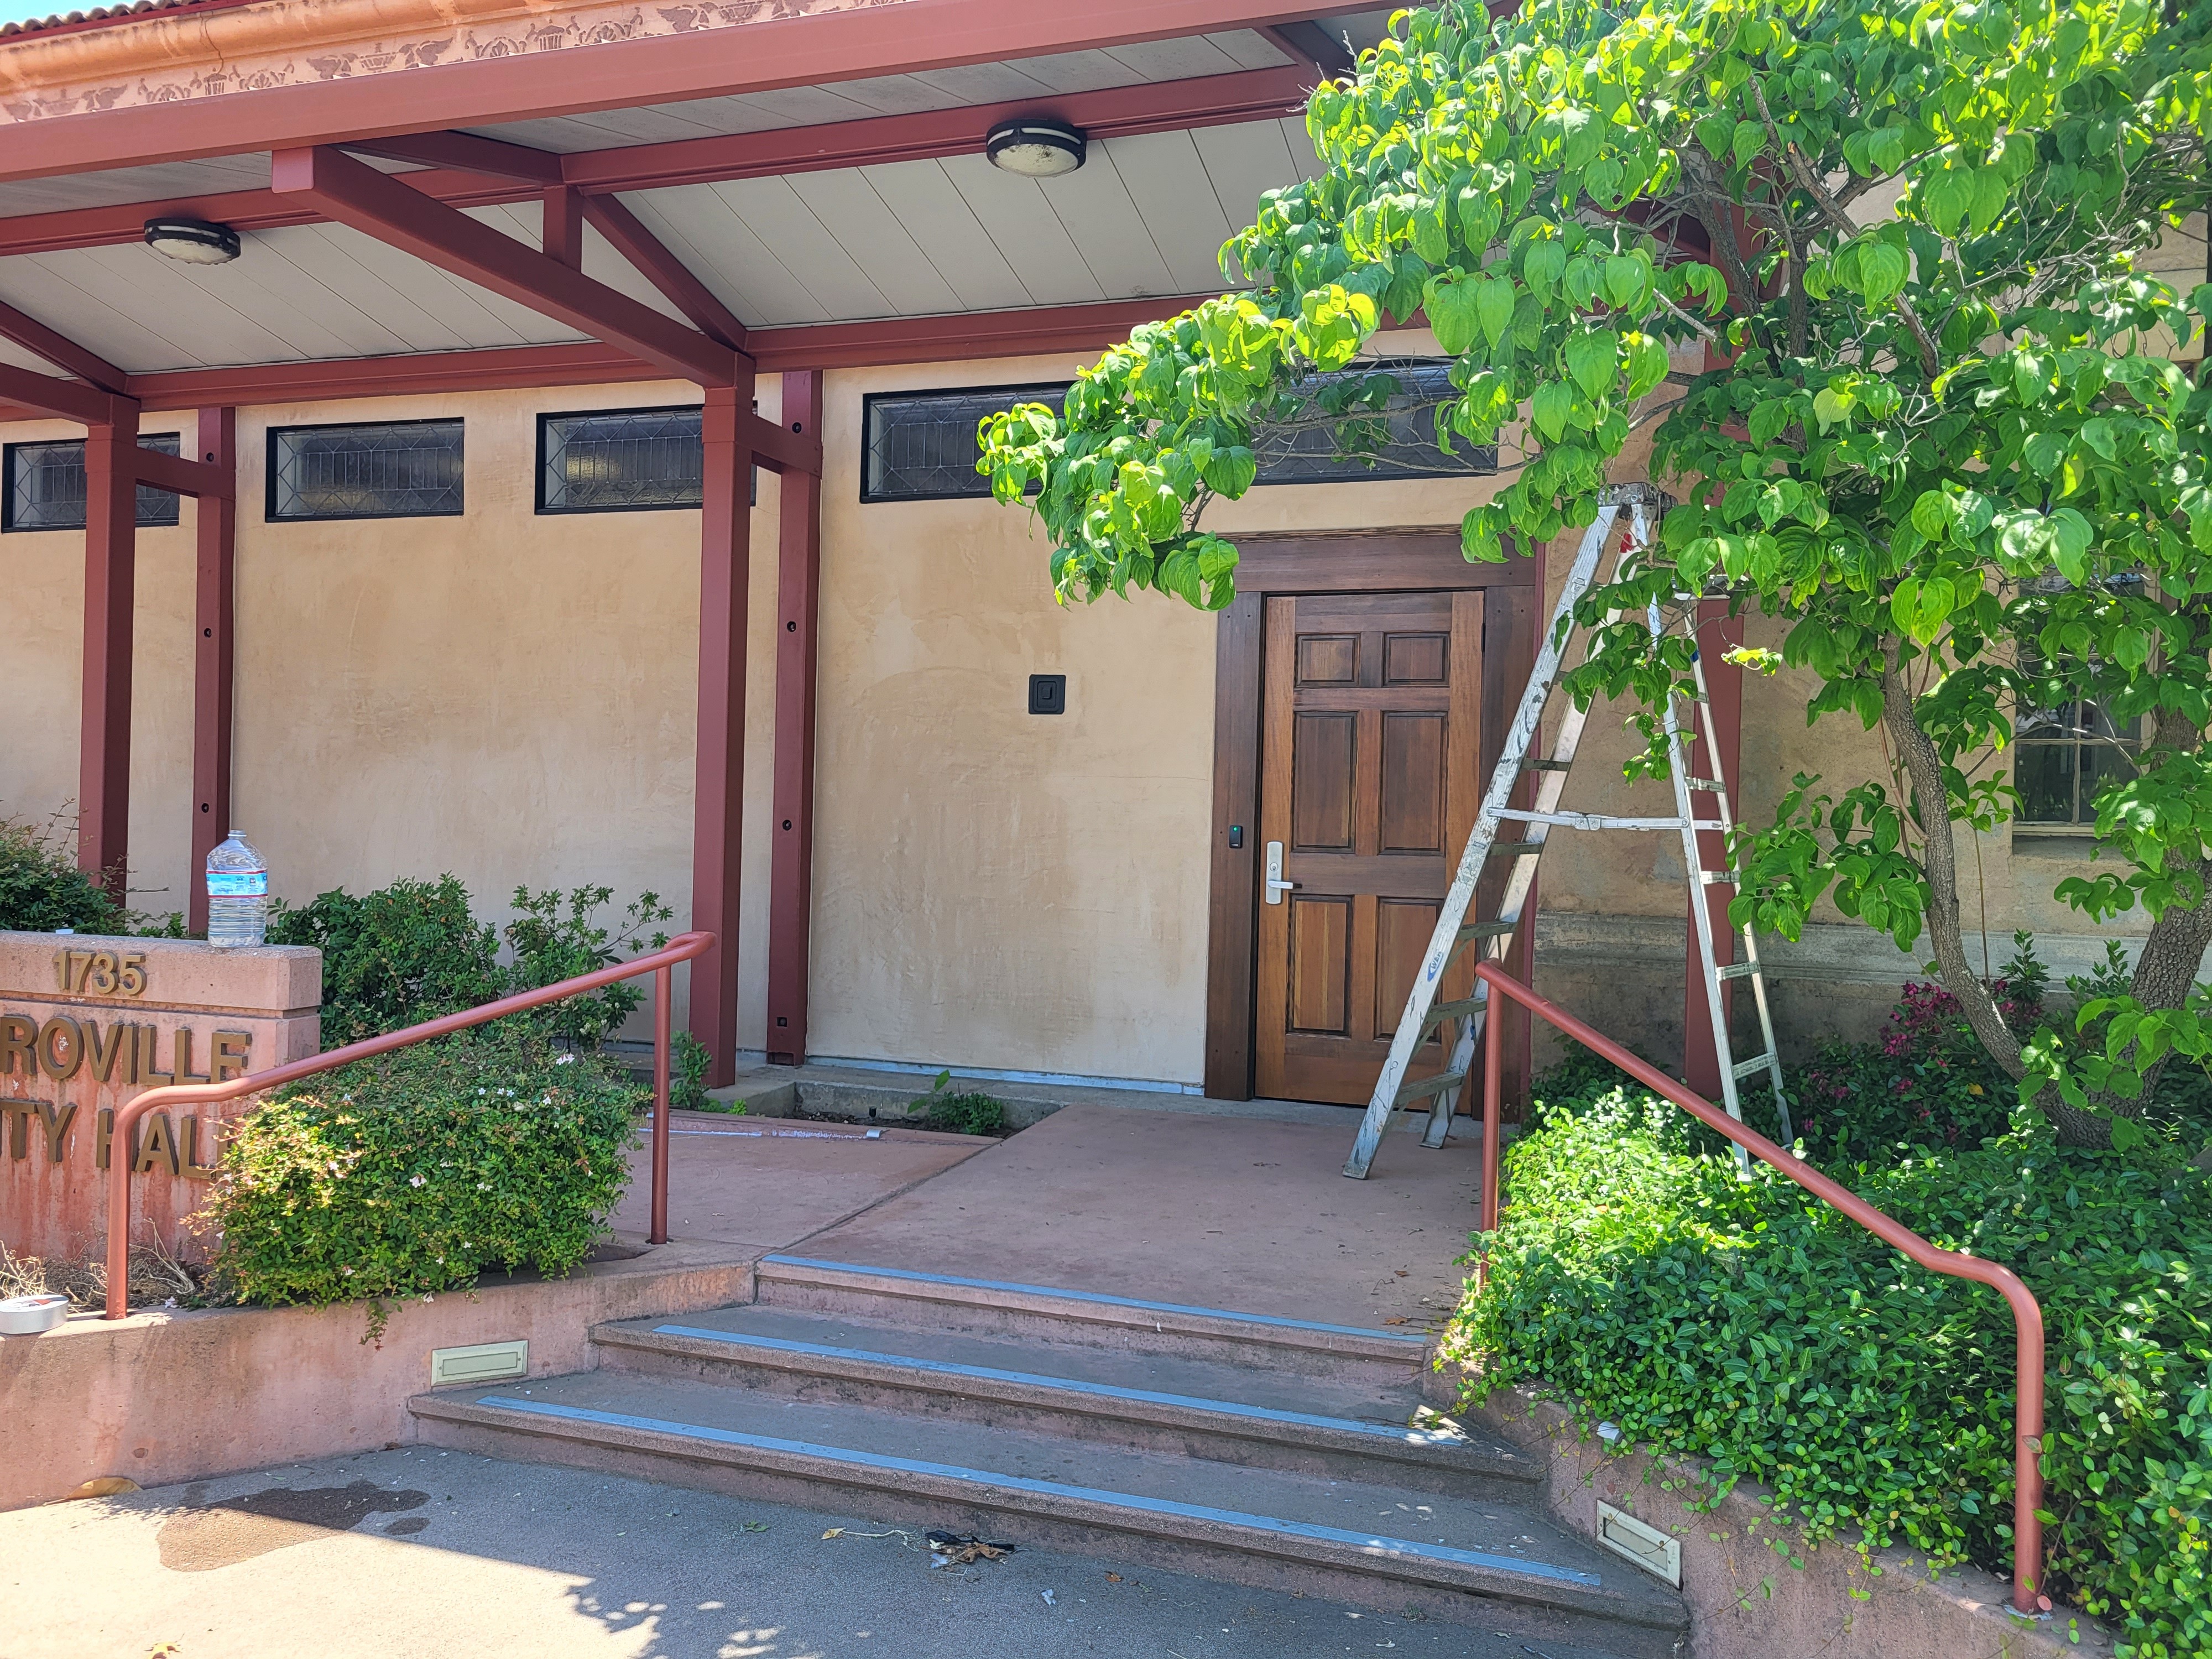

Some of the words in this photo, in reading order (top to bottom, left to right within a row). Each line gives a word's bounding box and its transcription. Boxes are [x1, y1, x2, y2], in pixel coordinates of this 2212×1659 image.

[53, 951, 147, 995] 1735
[0, 1015, 252, 1085] ROVILLE
[0, 1098, 78, 1162] TY
